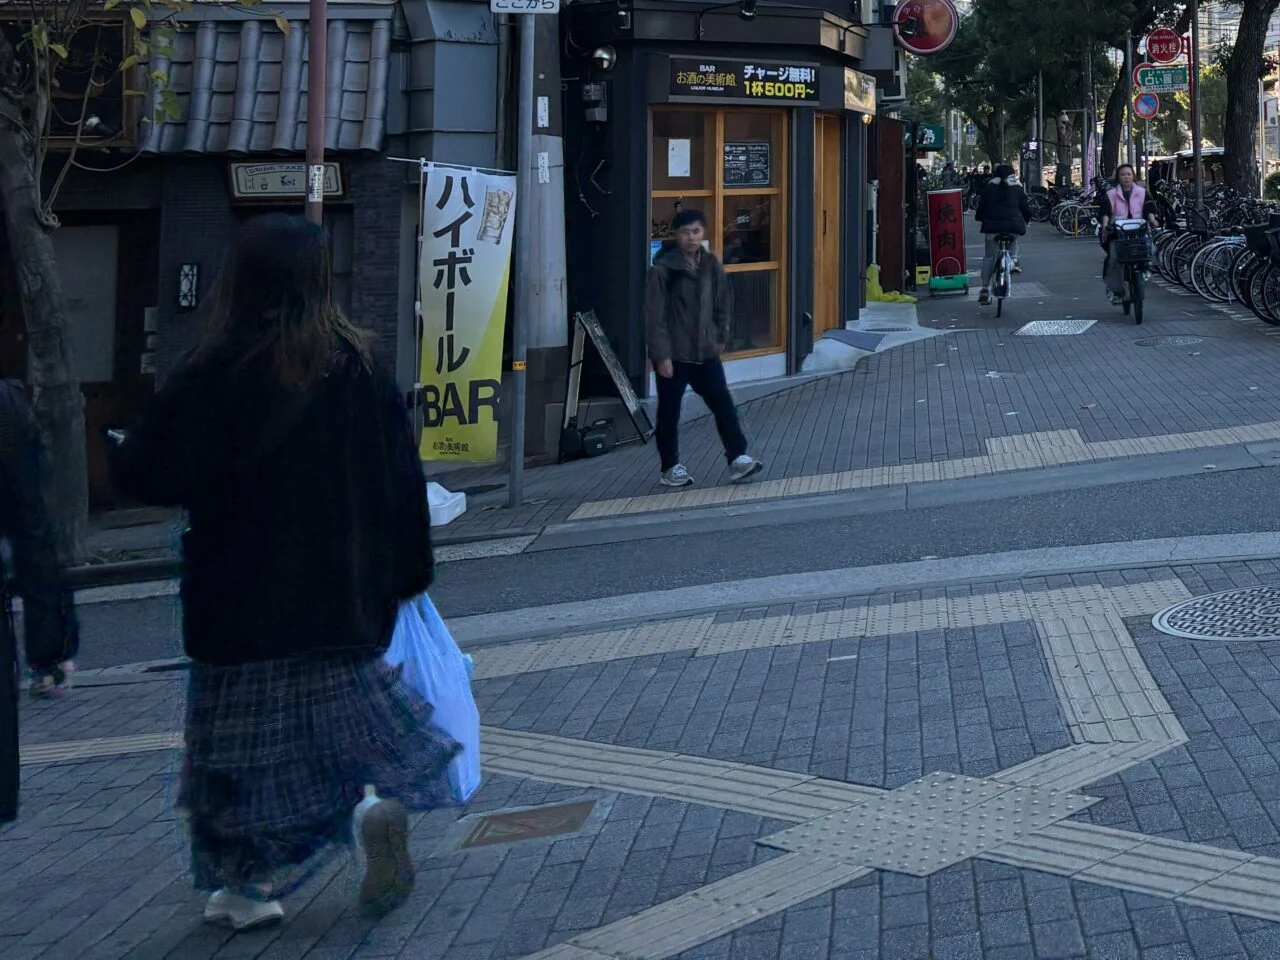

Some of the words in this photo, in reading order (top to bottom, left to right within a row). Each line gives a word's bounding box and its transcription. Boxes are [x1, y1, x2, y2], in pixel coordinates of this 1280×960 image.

[1152, 42, 1176, 54] 消火栓
[676, 71, 736, 86] お酒の美術館
[699, 64, 716, 73] BAR
[937, 202, 956, 252] 焼肉
[433, 176, 475, 375] ハイボール
[421, 378, 500, 428] BAR
